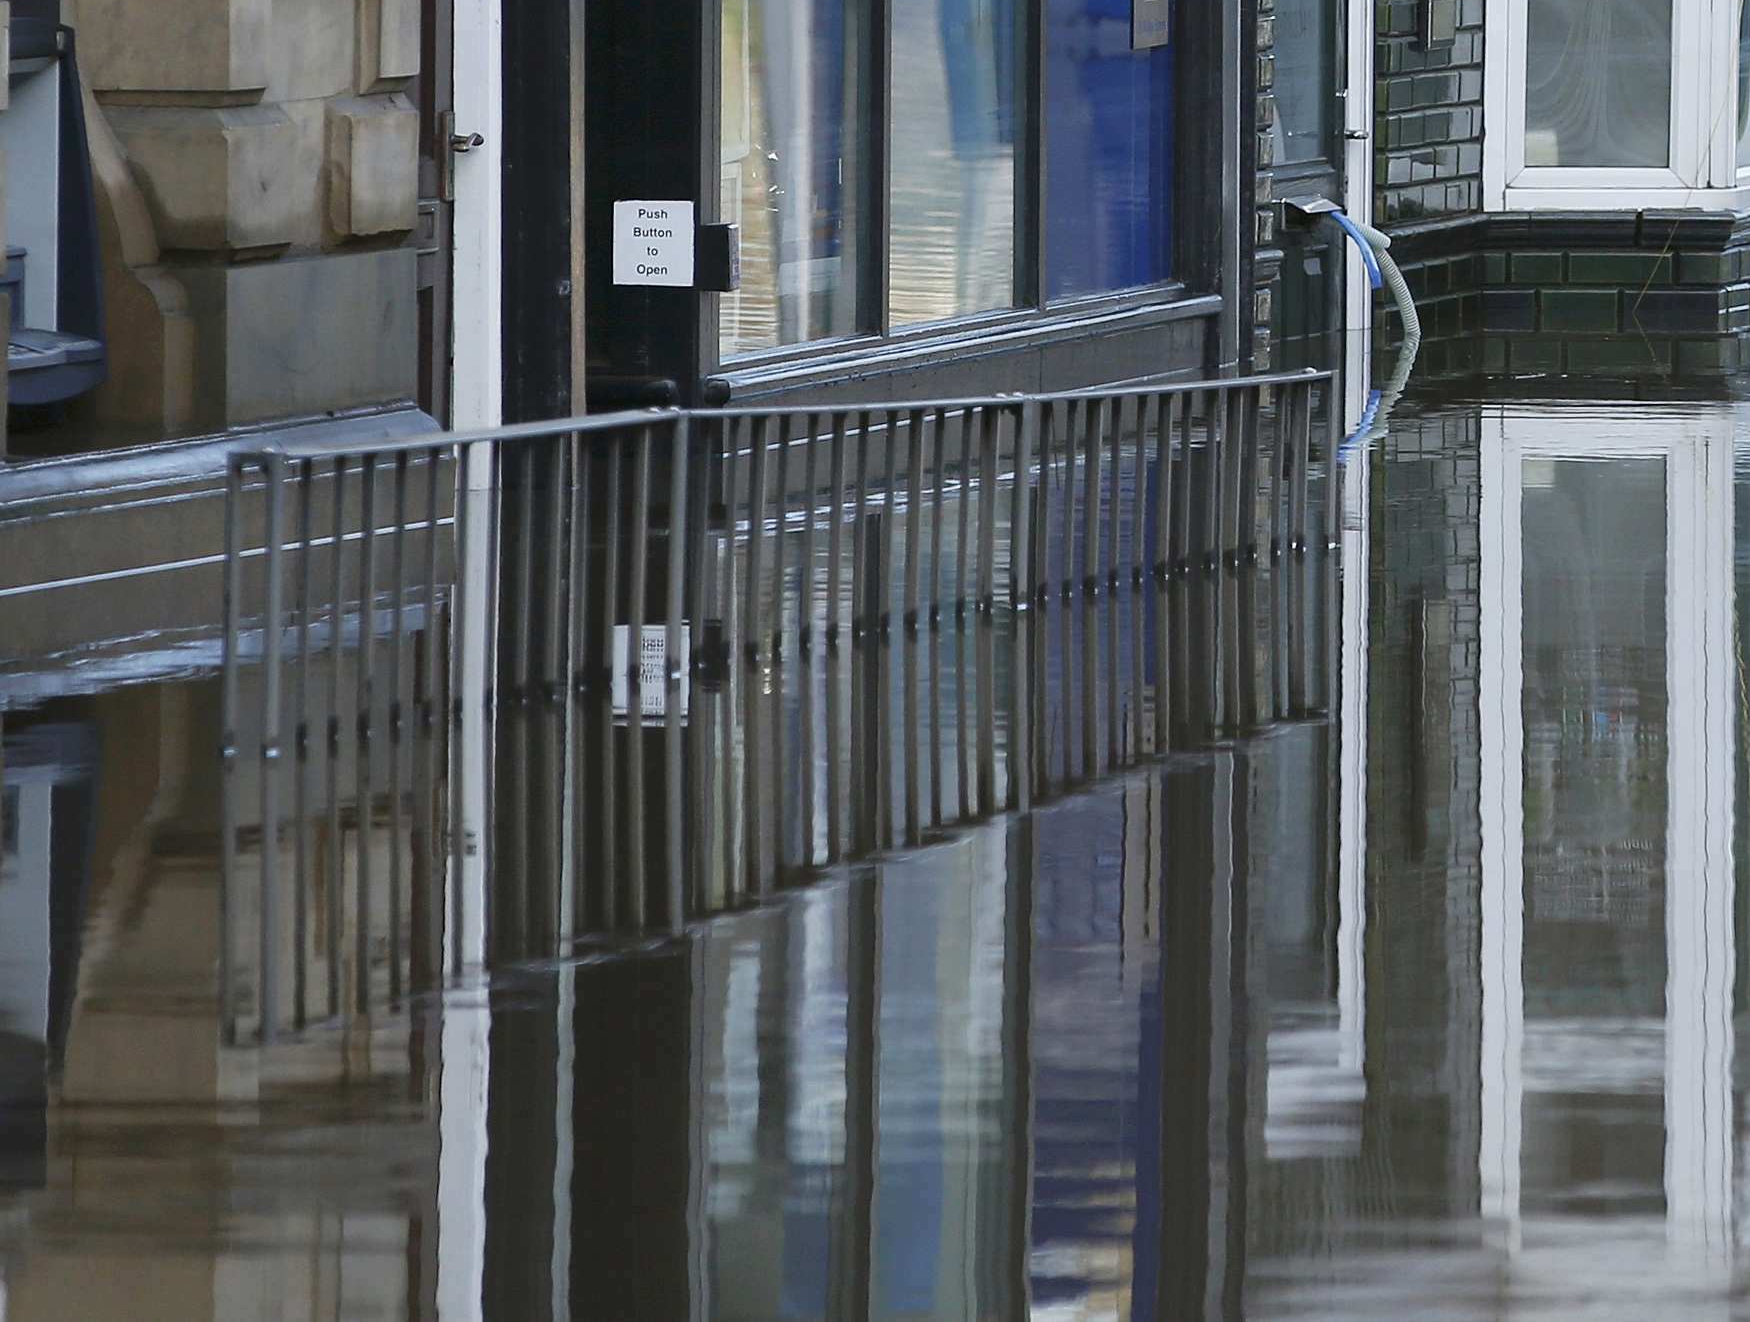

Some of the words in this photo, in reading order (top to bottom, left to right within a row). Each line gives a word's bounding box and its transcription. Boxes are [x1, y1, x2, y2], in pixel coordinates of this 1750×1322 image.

[637, 208, 668, 219] Push
[633, 227, 672, 237] Button
[647, 247, 658, 256] to
[636, 264, 668, 276] Open
